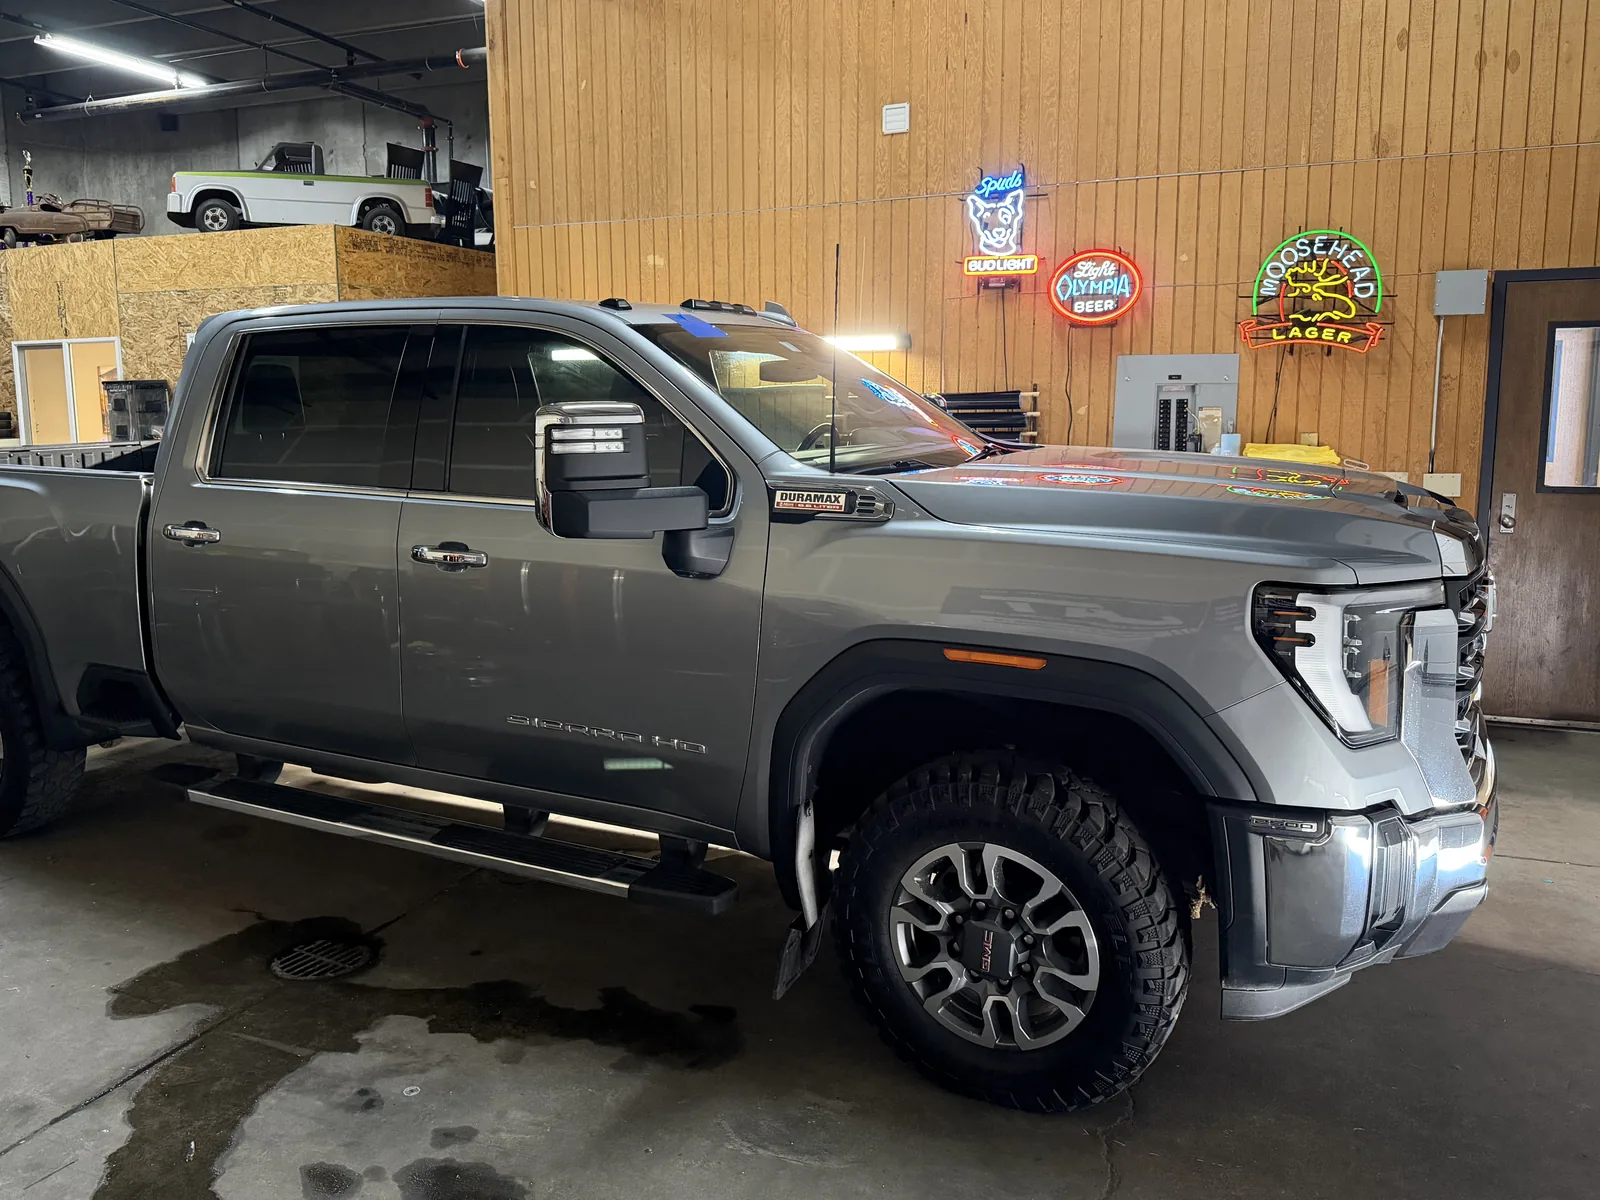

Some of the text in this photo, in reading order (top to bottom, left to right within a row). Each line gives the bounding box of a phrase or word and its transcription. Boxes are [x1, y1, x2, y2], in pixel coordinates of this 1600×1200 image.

[975, 169, 1022, 198] Spuds
[968, 257, 1035, 271] BUD LIGHT
[1073, 260, 1117, 280] Light
[1260, 235, 1375, 298] MOOSEHEAD
[1056, 274, 1130, 300] OLYMPIA
[1074, 299, 1115, 313] BEER
[1272, 326, 1352, 343] LAGER
[780, 492, 841, 504] DURAMAX
[506, 714, 706, 754] SIERRA HD
[982, 930, 994, 973] GMC
